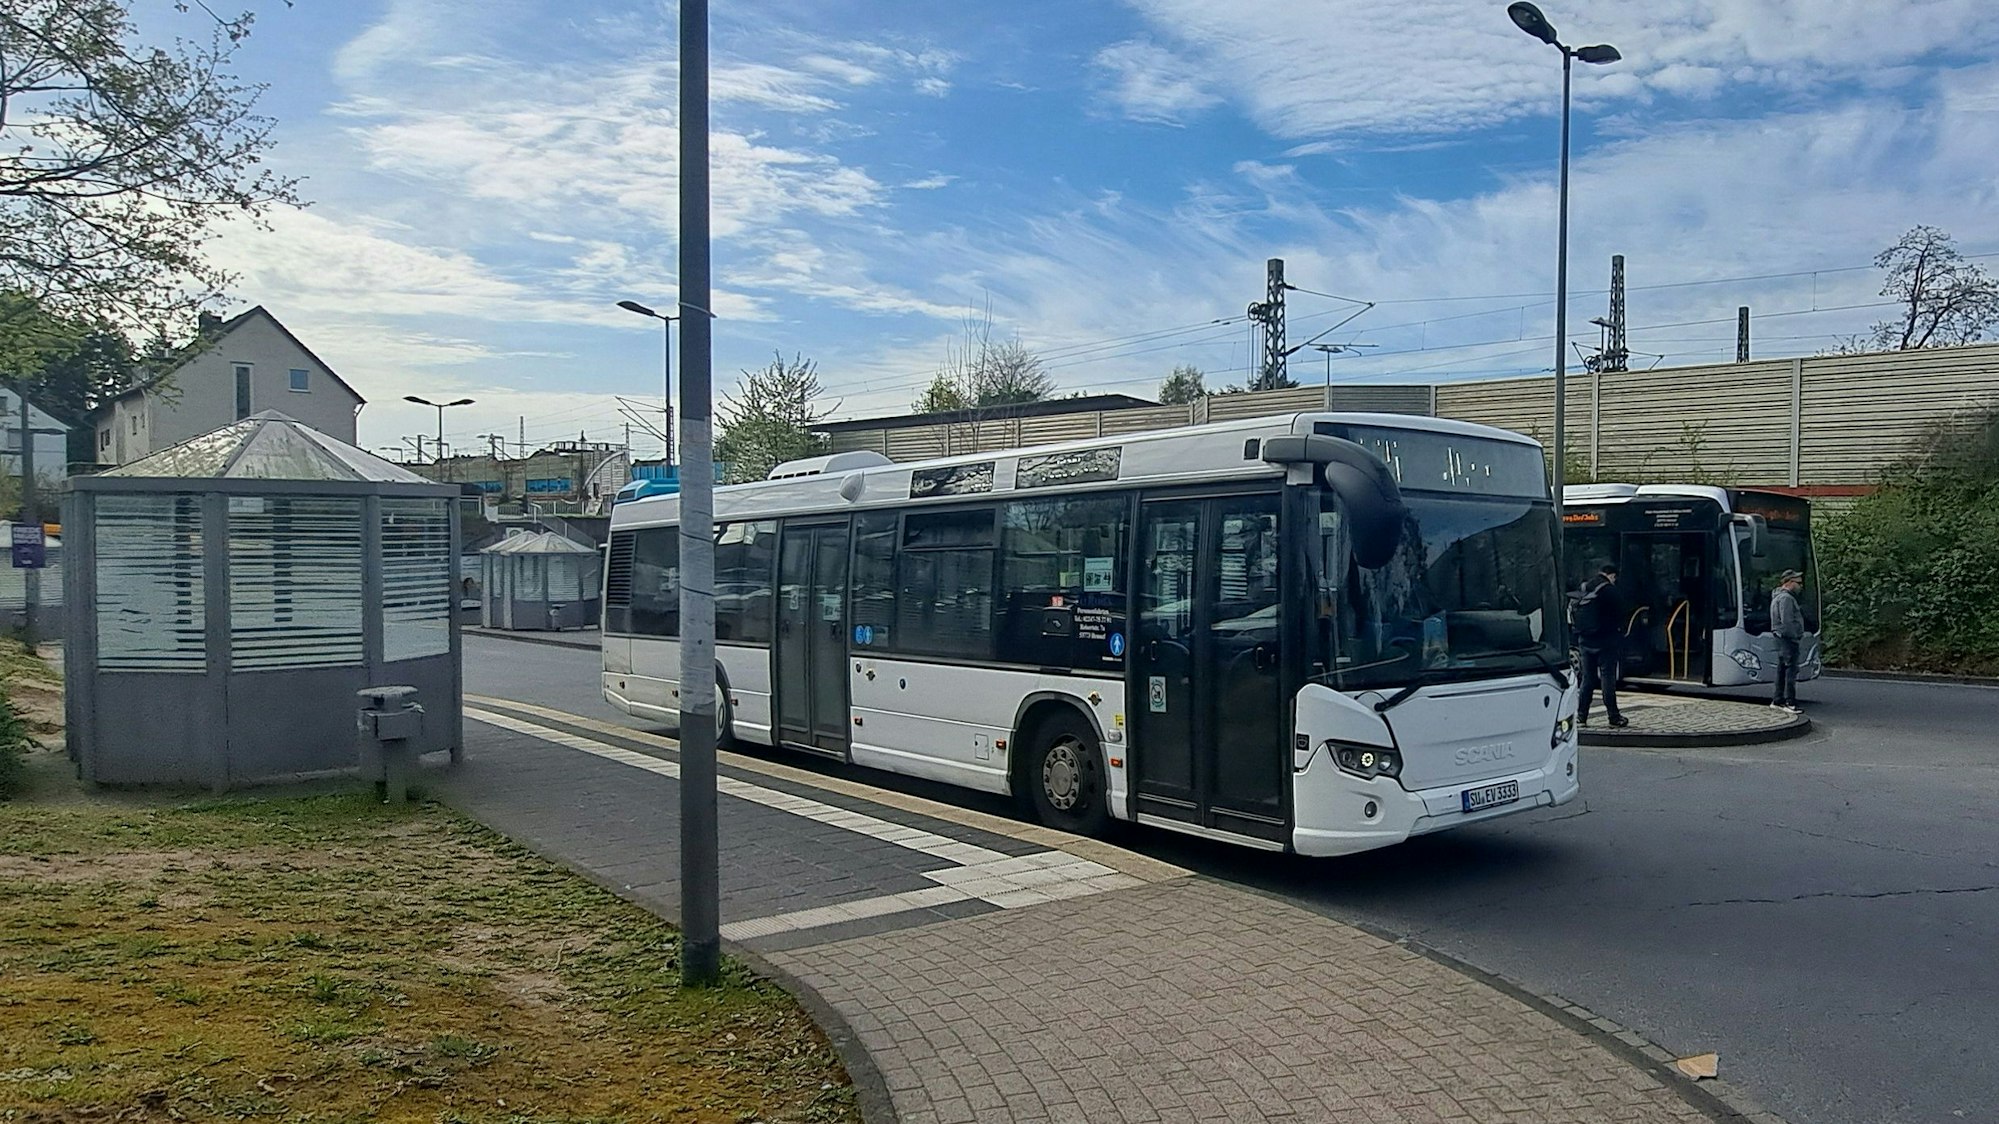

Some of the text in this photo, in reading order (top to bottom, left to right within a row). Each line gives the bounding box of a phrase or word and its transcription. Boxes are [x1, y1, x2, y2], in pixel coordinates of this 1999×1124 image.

[1455, 741, 1516, 767] SCANIA
[1470, 783, 1517, 806] SU EV 3333
